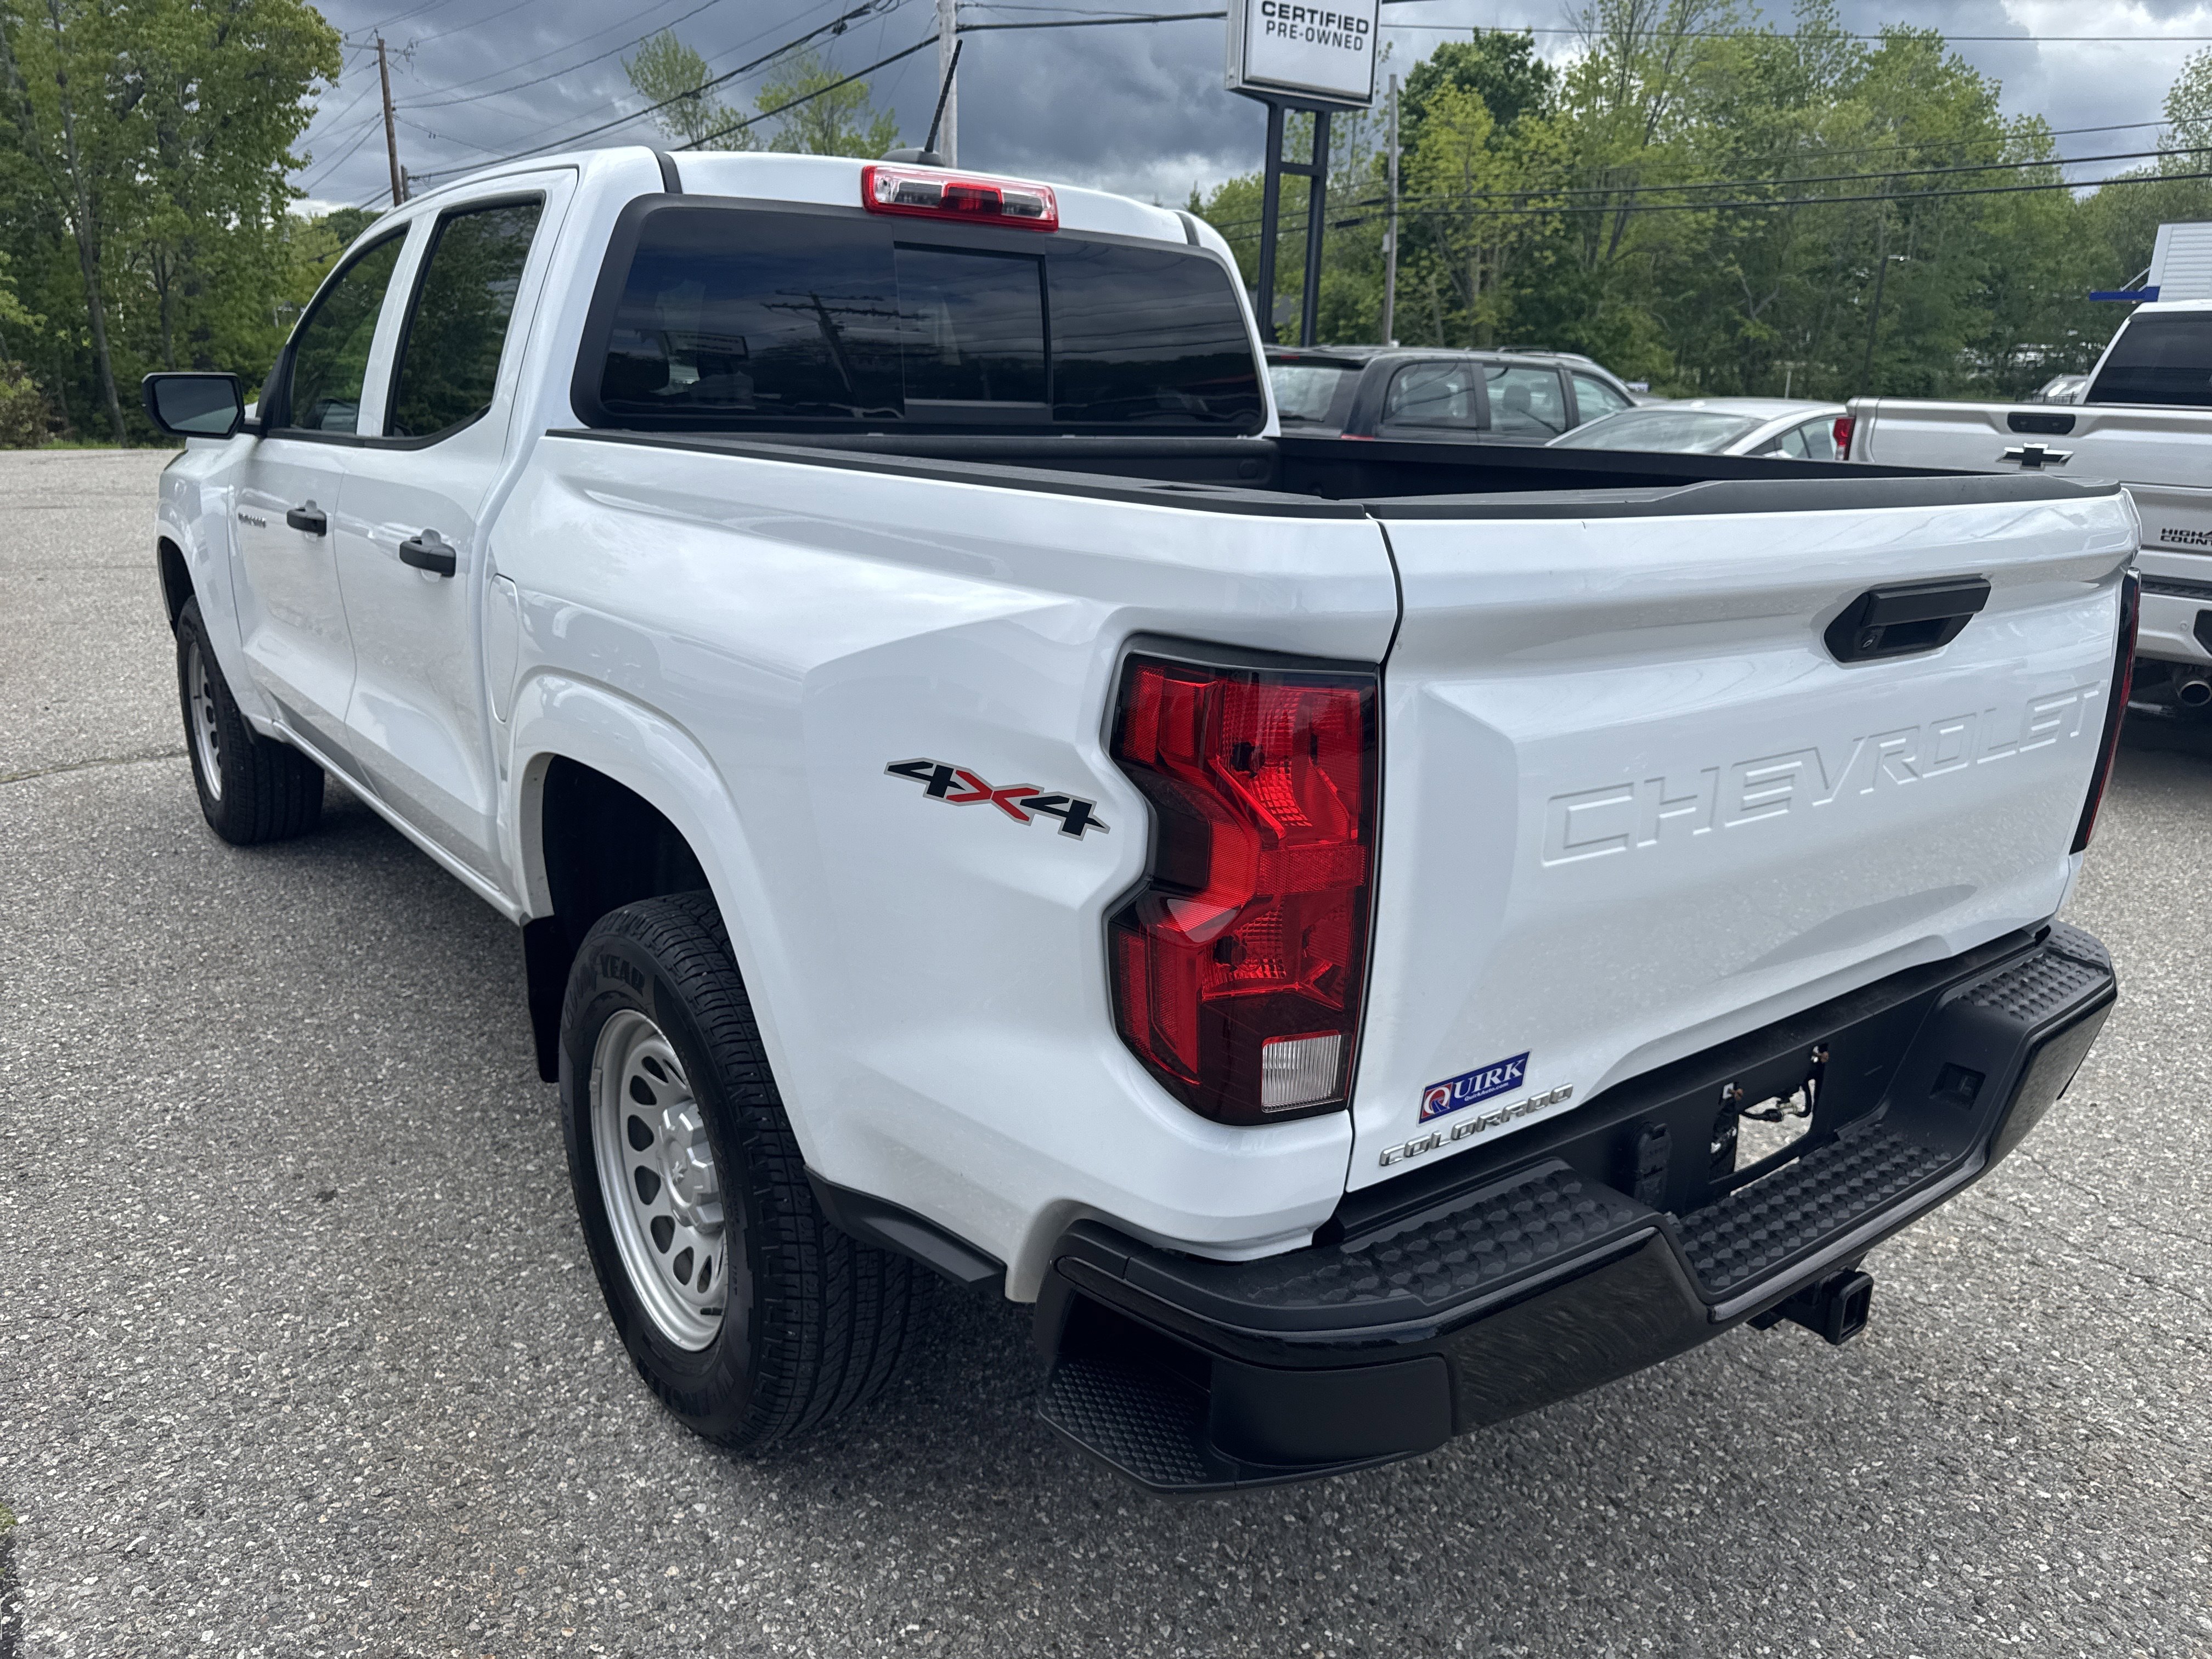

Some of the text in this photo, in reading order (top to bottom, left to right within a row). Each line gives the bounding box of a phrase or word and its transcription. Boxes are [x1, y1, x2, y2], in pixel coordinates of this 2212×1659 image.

[1262, 1, 1369, 34] CERTIFIED
[1266, 20, 1363, 50] PRE-OWNED
[2162, 528, 2203, 538] HIGH
[1542, 679, 2108, 866] CHEVROLET
[1423, 1058, 1525, 1115] QUIRK
[1464, 1082, 1509, 1102] QuirkAuto.com
[1378, 1082, 1574, 1166] COLORADO
